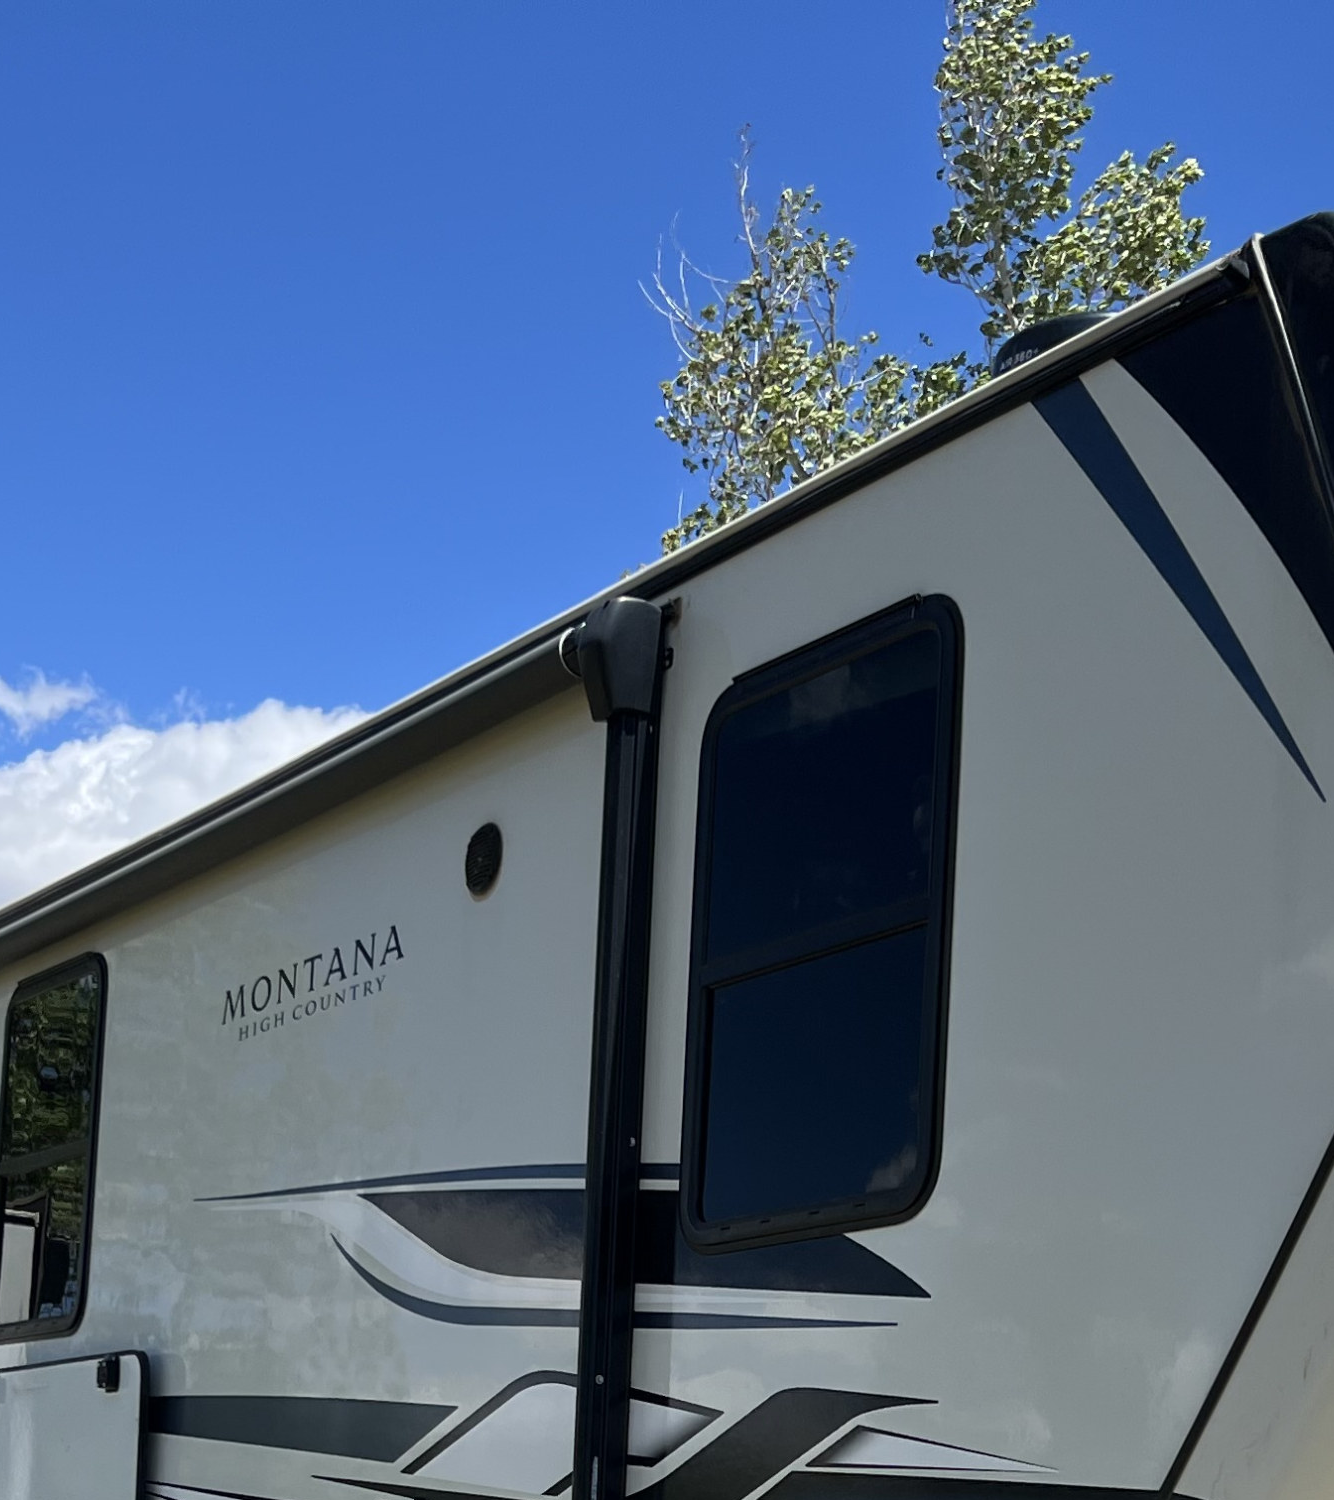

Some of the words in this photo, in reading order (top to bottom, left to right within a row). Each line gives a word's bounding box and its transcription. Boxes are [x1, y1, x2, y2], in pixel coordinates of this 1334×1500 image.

[221, 924, 405, 1026] MONTANA
[238, 1011, 285, 1041] HIGH
[292, 975, 387, 1021] COUNTRY
